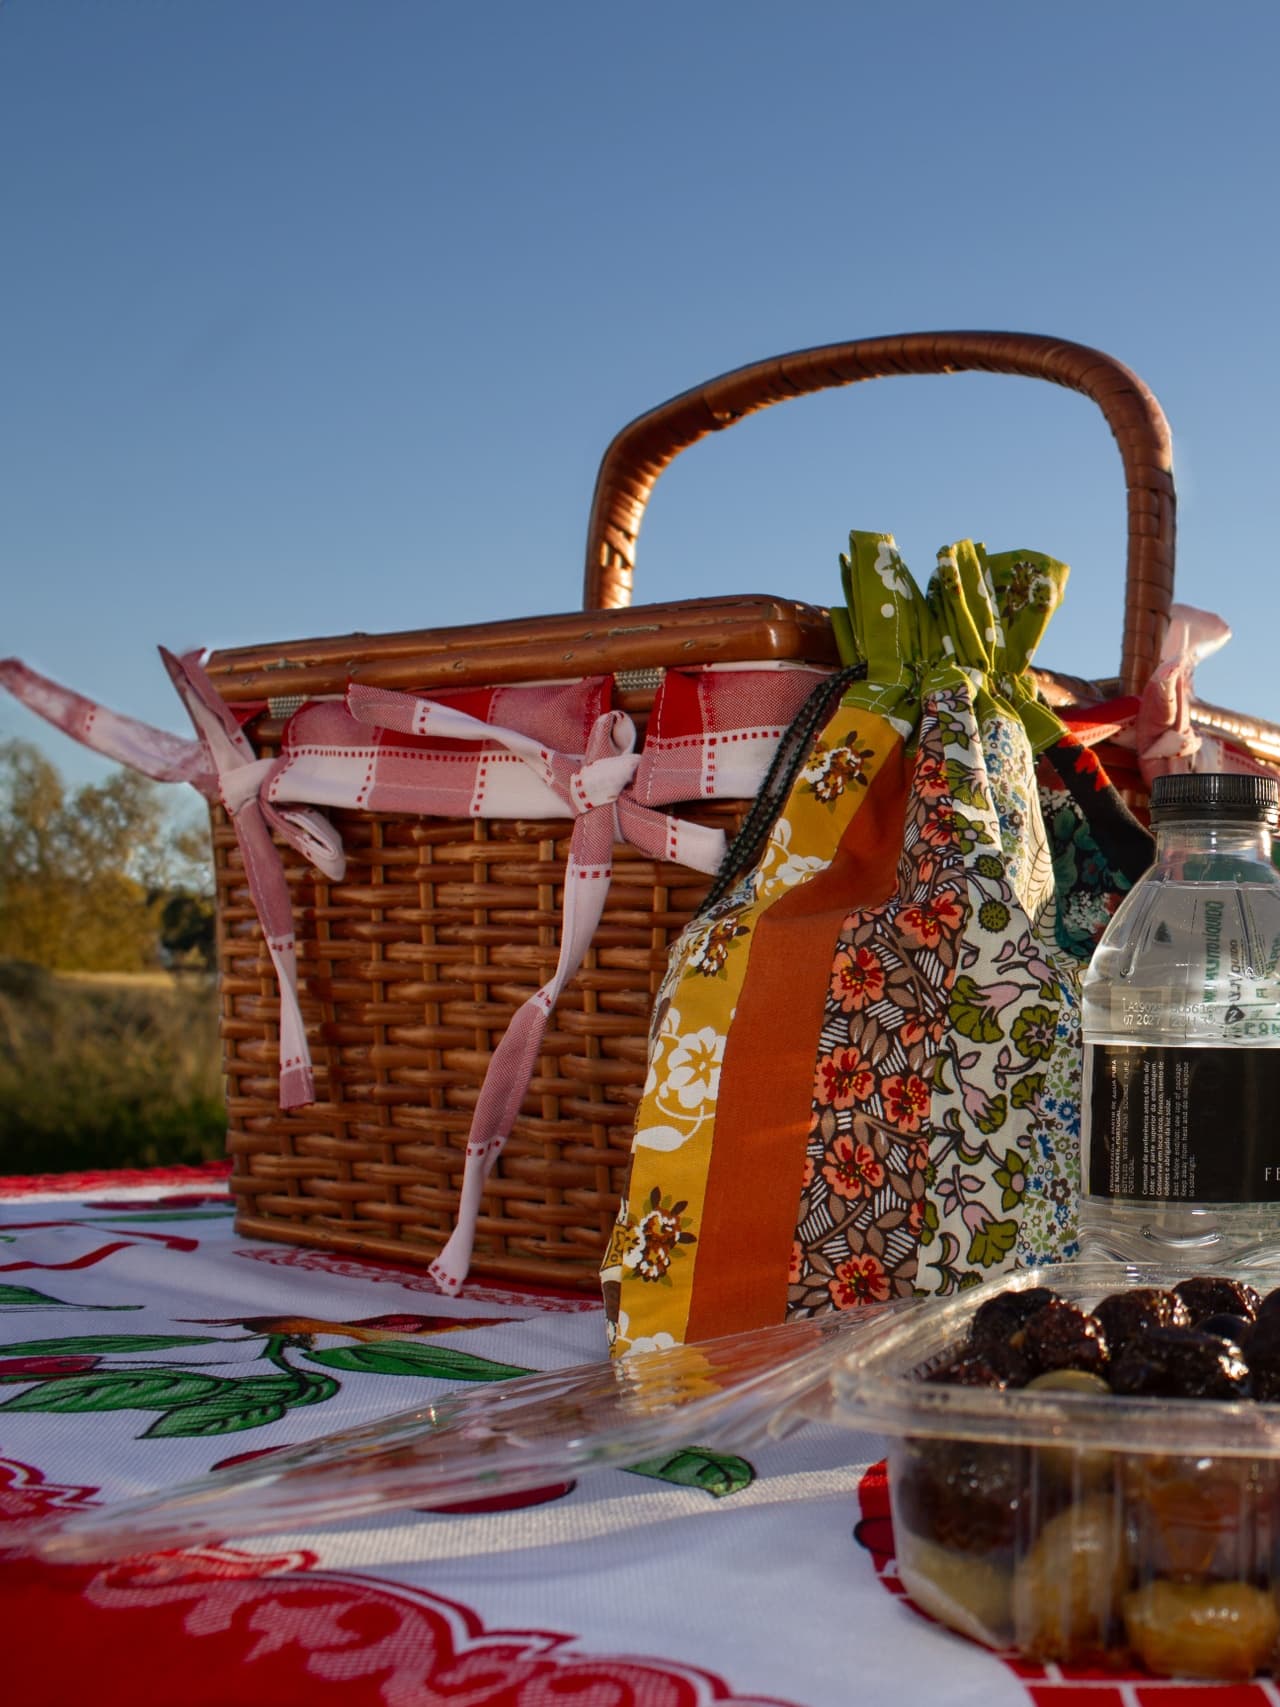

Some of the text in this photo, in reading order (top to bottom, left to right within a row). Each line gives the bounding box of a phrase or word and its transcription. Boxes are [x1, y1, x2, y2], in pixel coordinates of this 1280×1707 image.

[1158, 1061, 1164, 1070] de
[1143, 1086, 1149, 1095] do
[1150, 1104, 1156, 1112] da
[1164, 1128, 1171, 1136] da
[1158, 1151, 1163, 1161] em
